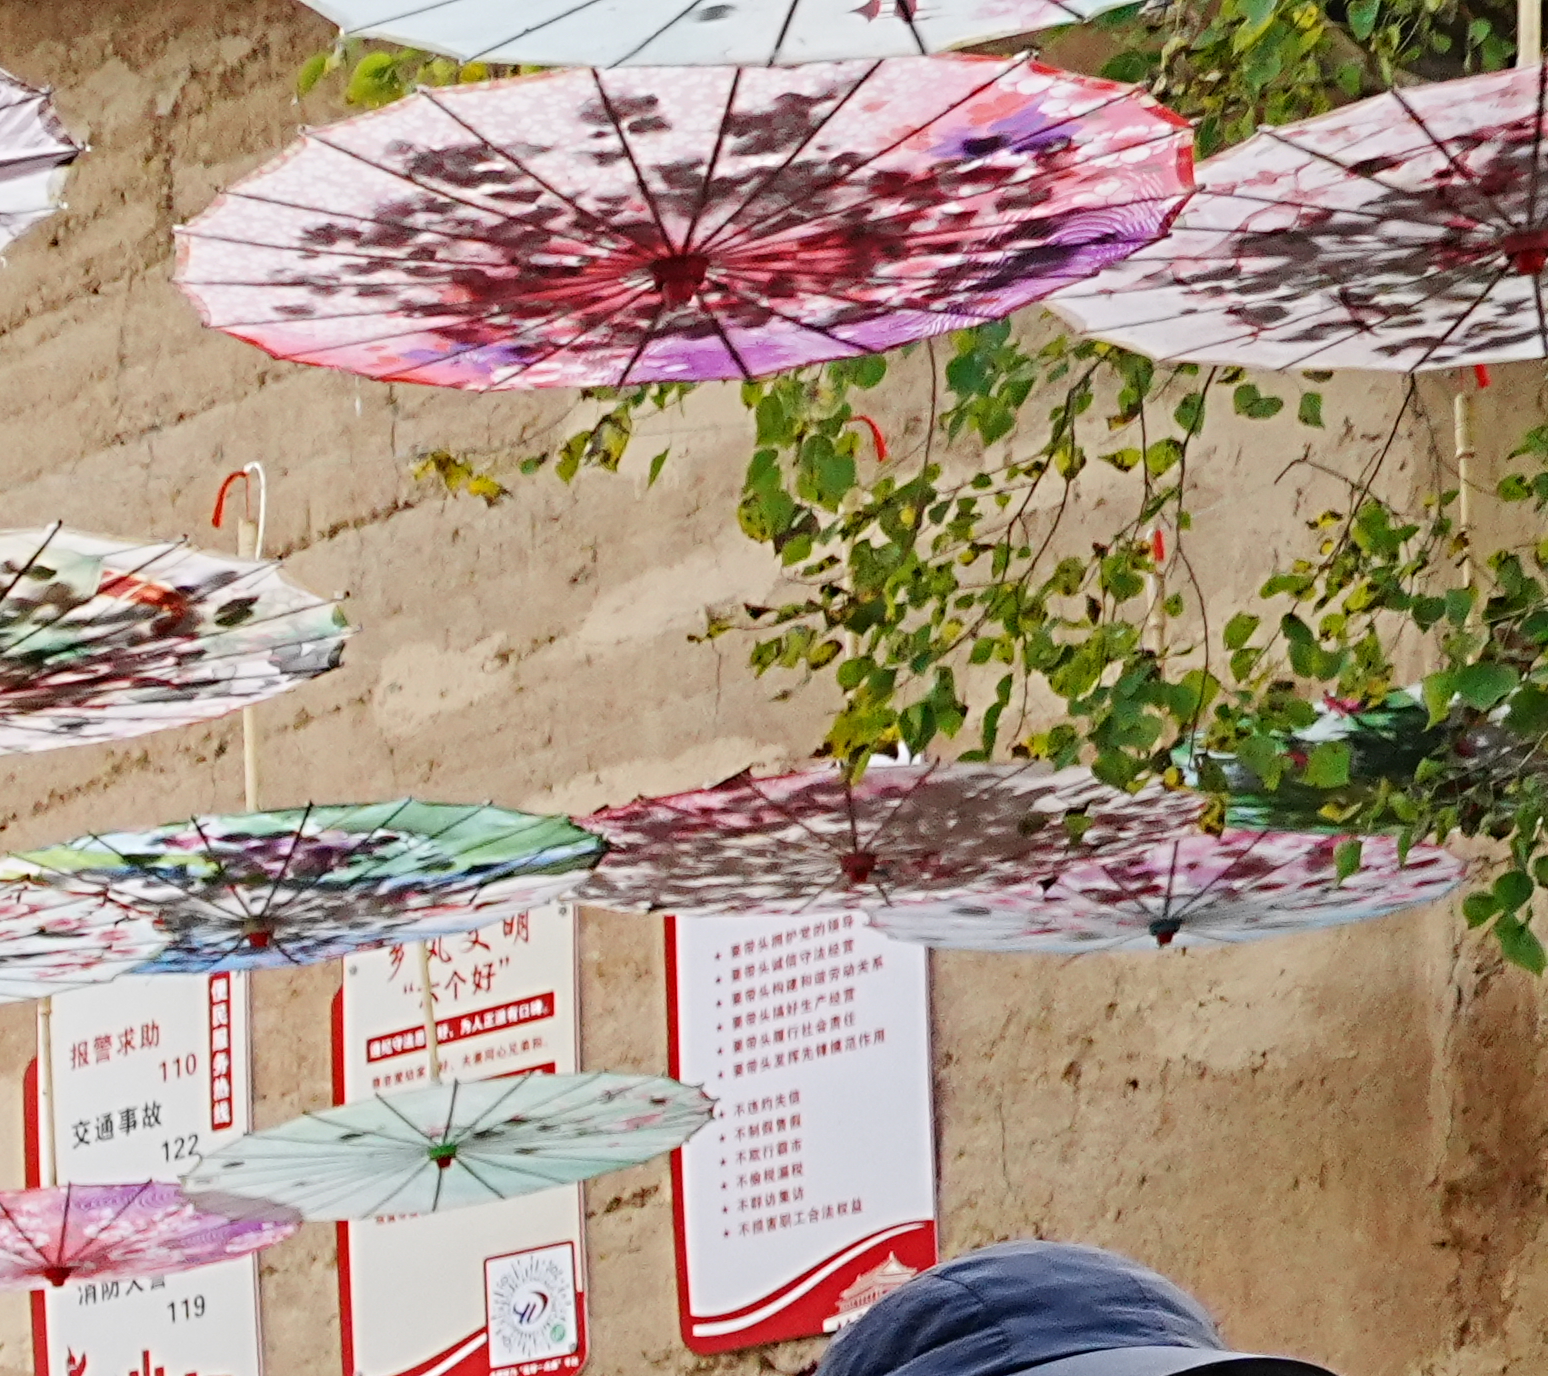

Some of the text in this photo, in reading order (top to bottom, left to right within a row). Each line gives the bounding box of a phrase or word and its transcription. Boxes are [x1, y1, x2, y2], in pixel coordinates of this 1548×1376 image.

[69, 1019, 161, 1071] 报警求助
[159, 1053, 198, 1083] 110
[70, 1099, 164, 1150] 交通事故
[161, 1134, 200, 1164] 122
[166, 1294, 206, 1324] 119
